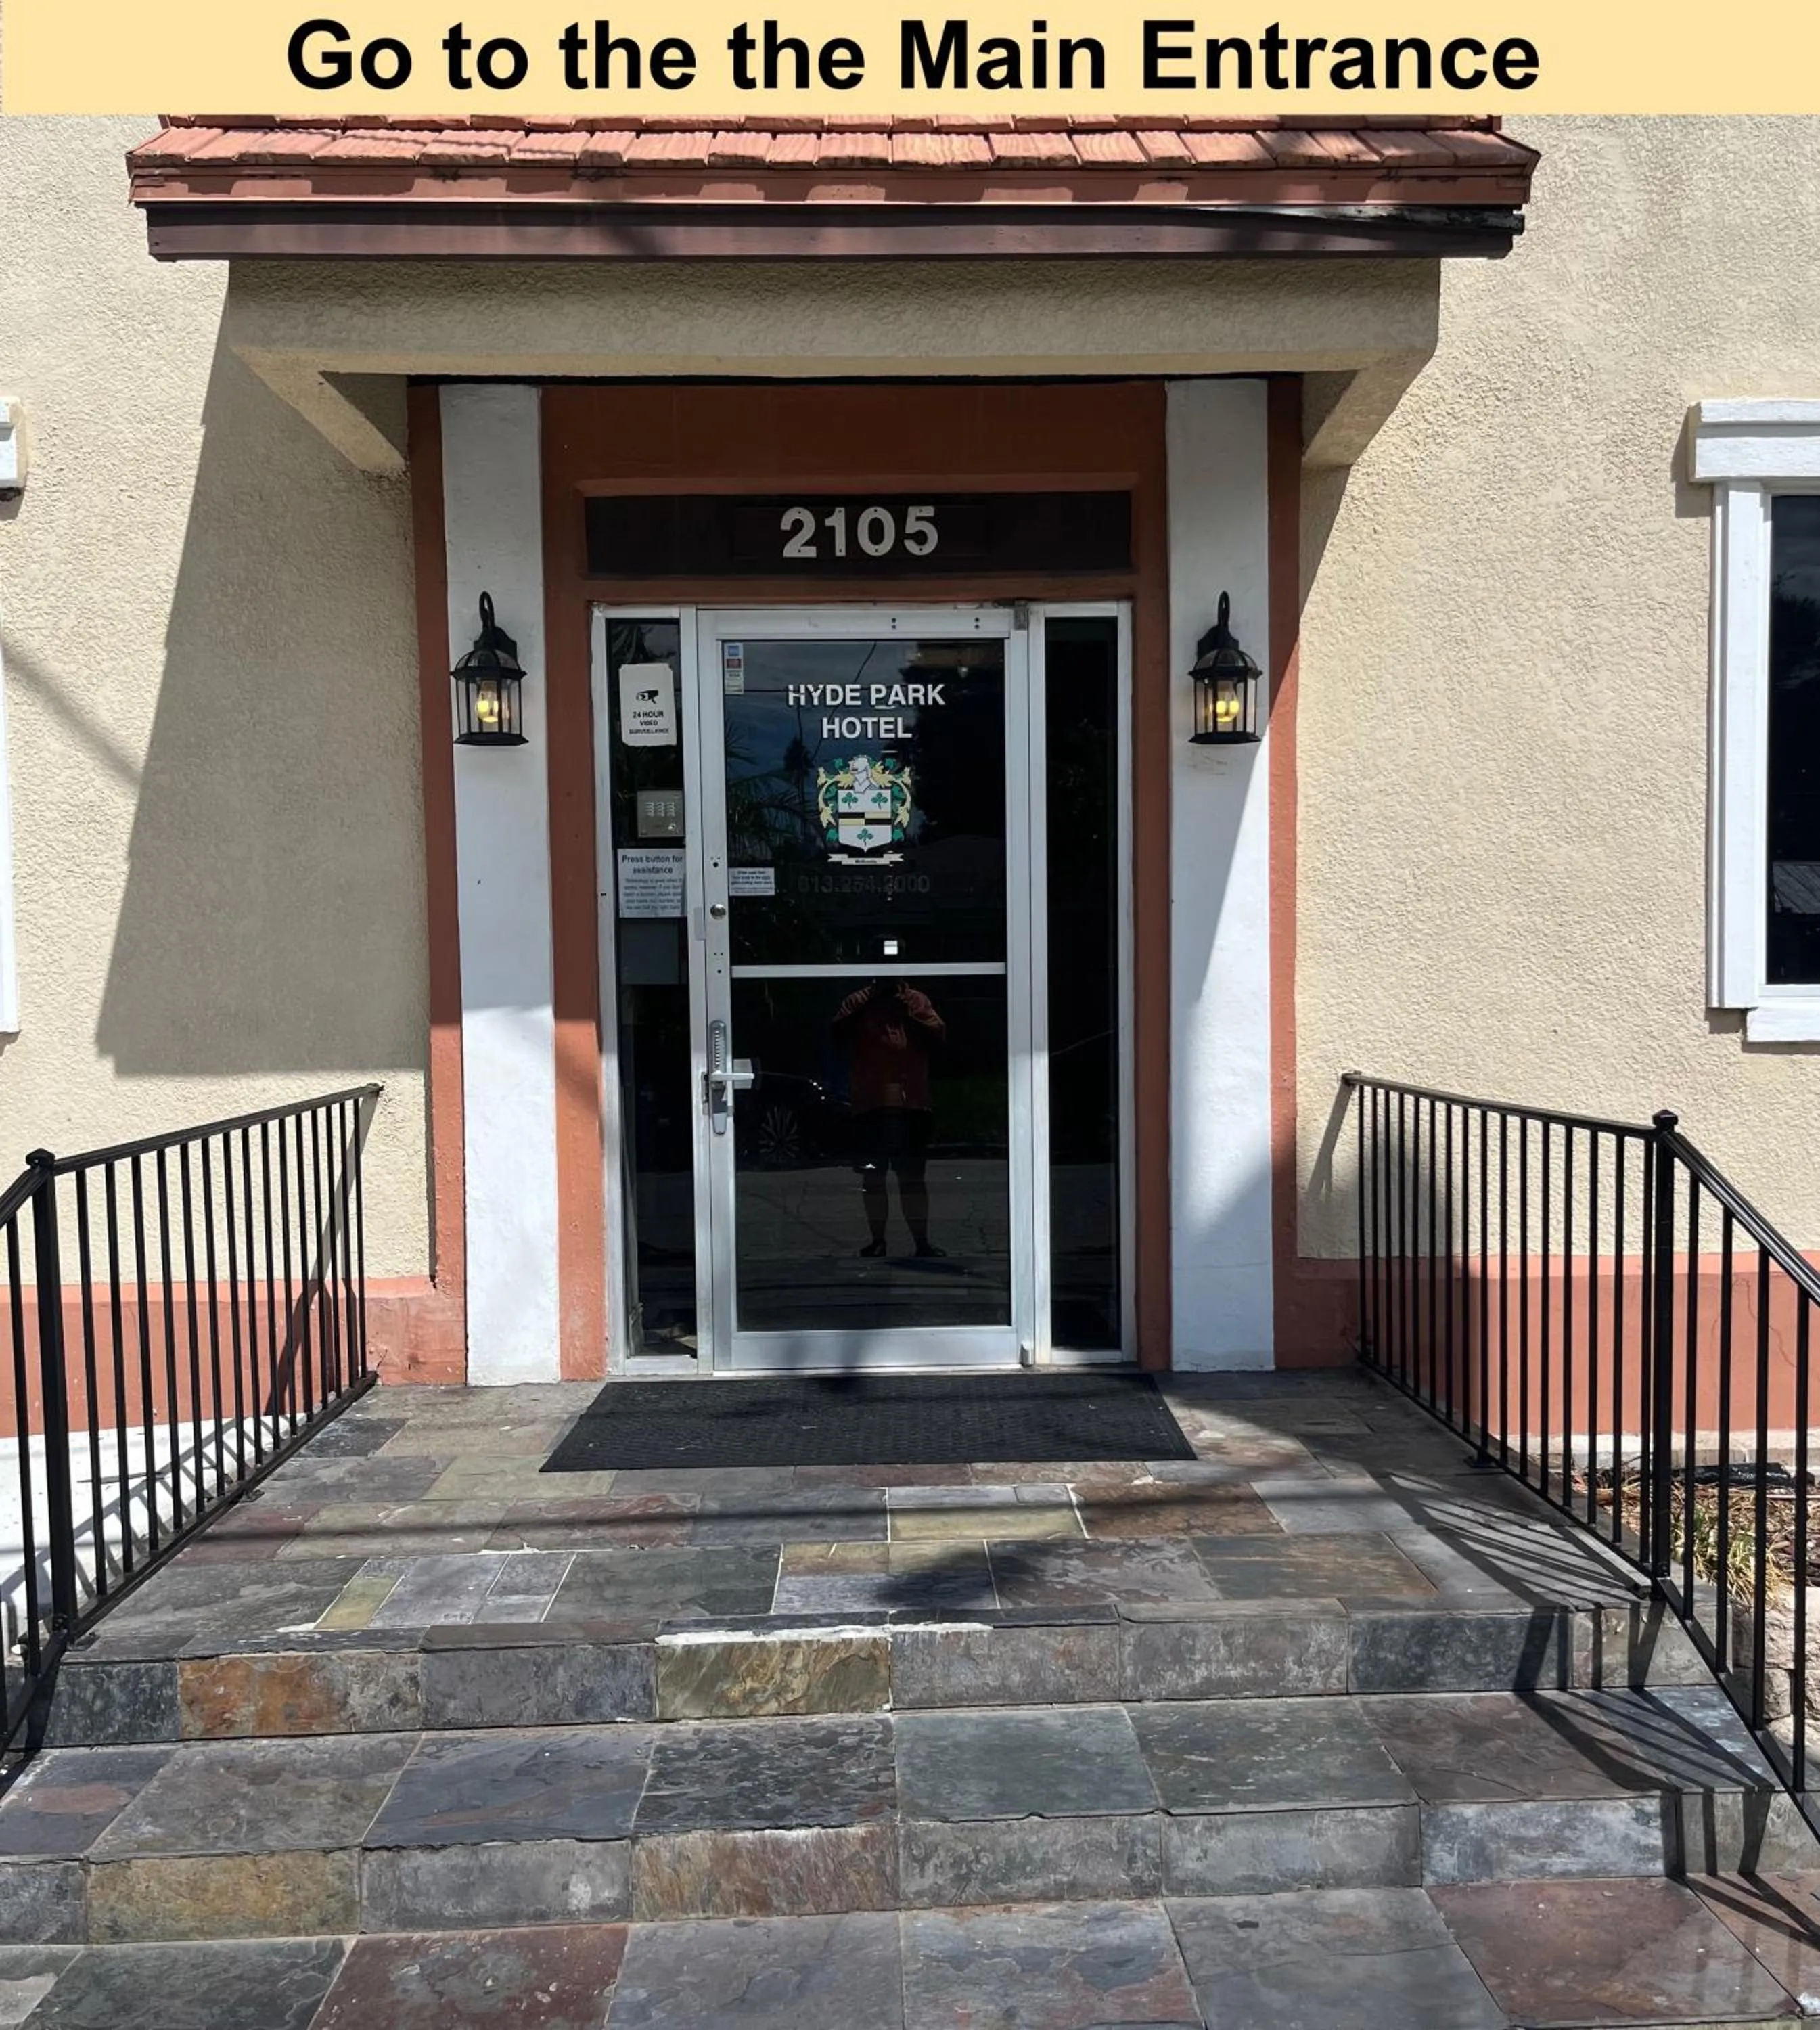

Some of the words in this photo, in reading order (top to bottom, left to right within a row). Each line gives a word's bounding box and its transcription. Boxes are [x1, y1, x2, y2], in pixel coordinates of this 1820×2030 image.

[781, 506, 938, 558] 2105
[788, 684, 861, 706] HYDE
[871, 684, 945, 706] PARK
[643, 710, 664, 718] HOUR
[822, 717, 913, 738] HOTEL
[622, 855, 643, 863] Press
[645, 855, 670, 863] button
[670, 855, 683, 863] for
